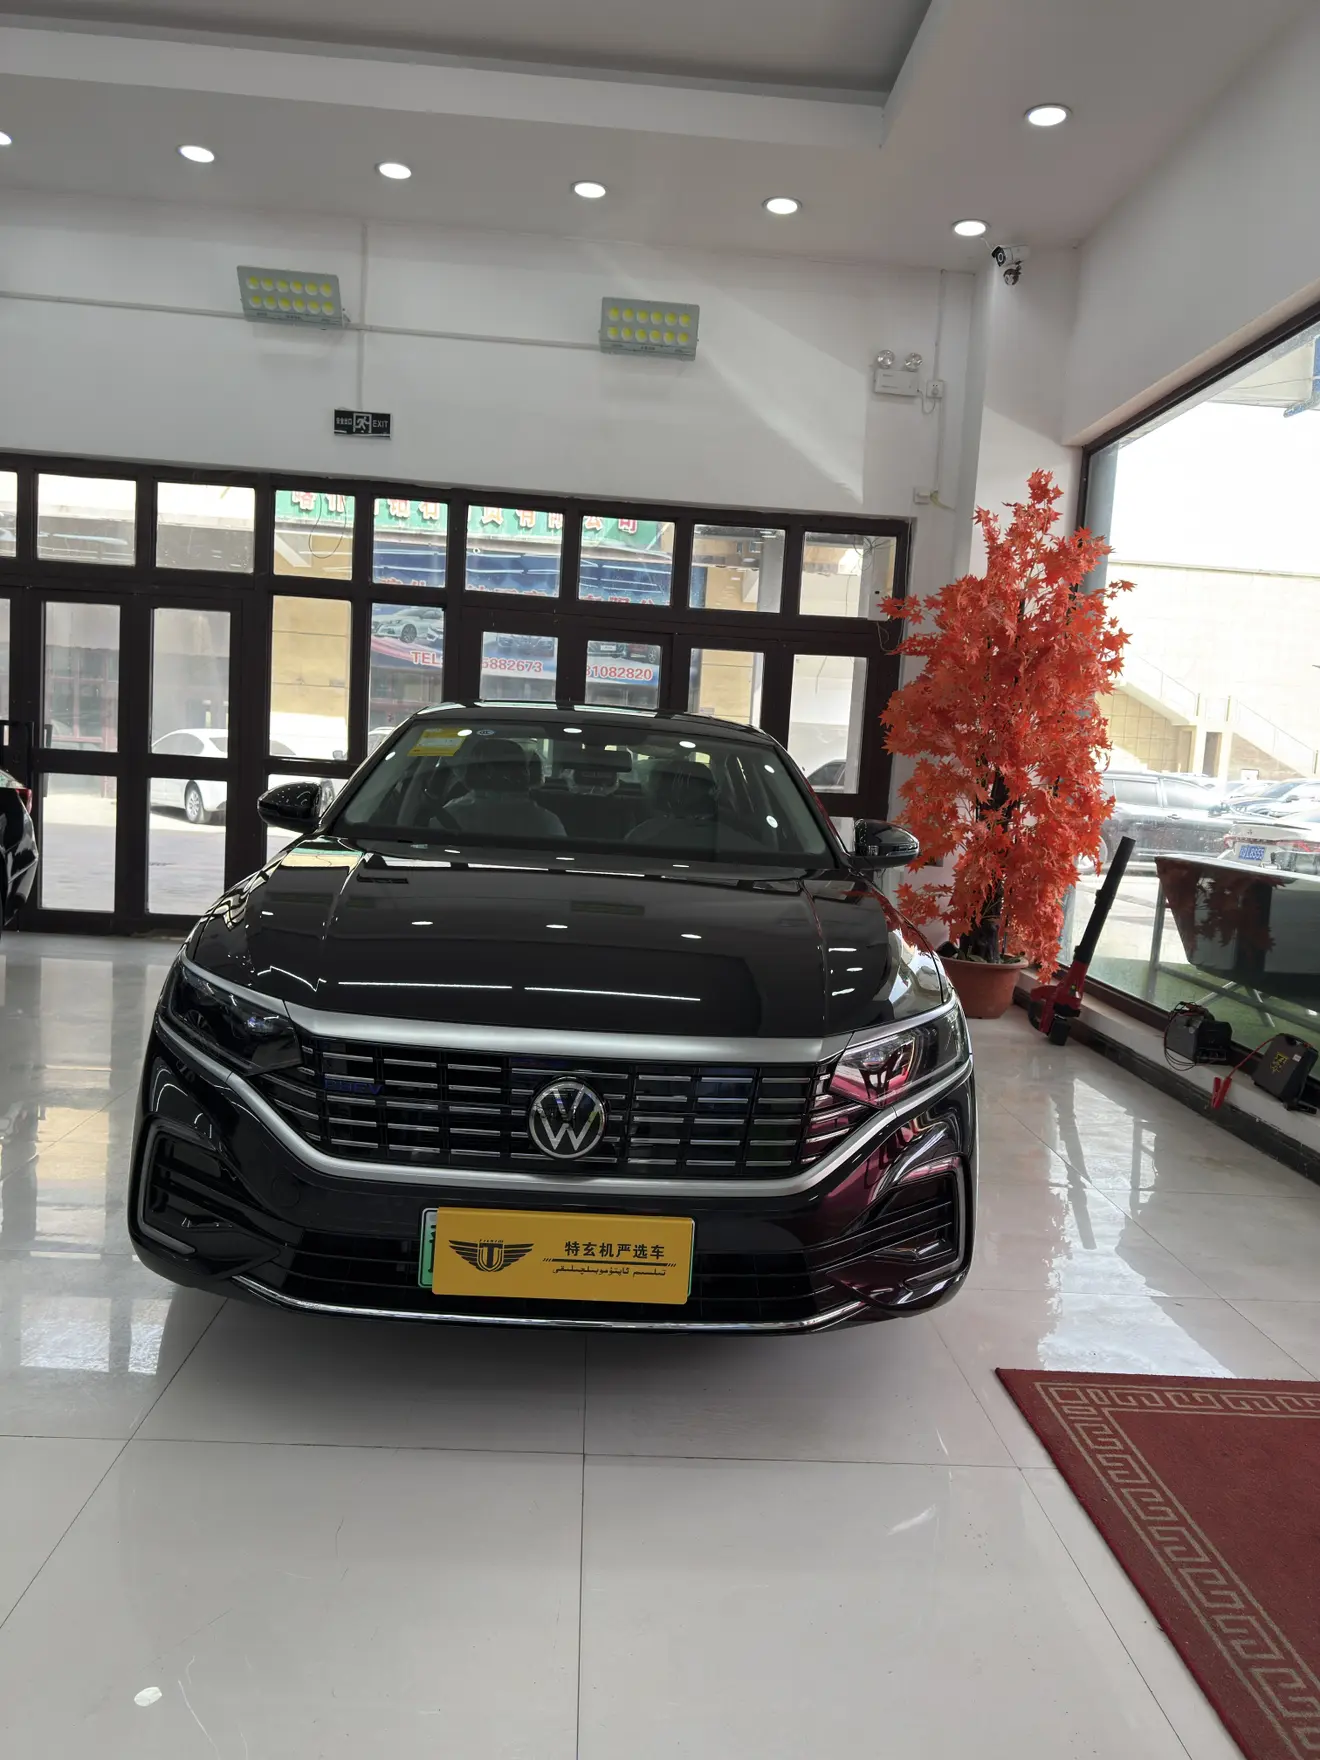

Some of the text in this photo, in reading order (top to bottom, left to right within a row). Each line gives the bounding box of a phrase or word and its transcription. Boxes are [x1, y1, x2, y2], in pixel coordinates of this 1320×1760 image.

[373, 419, 388, 428] EXIT
[565, 1241, 665, 1260] 特玄机严选车
